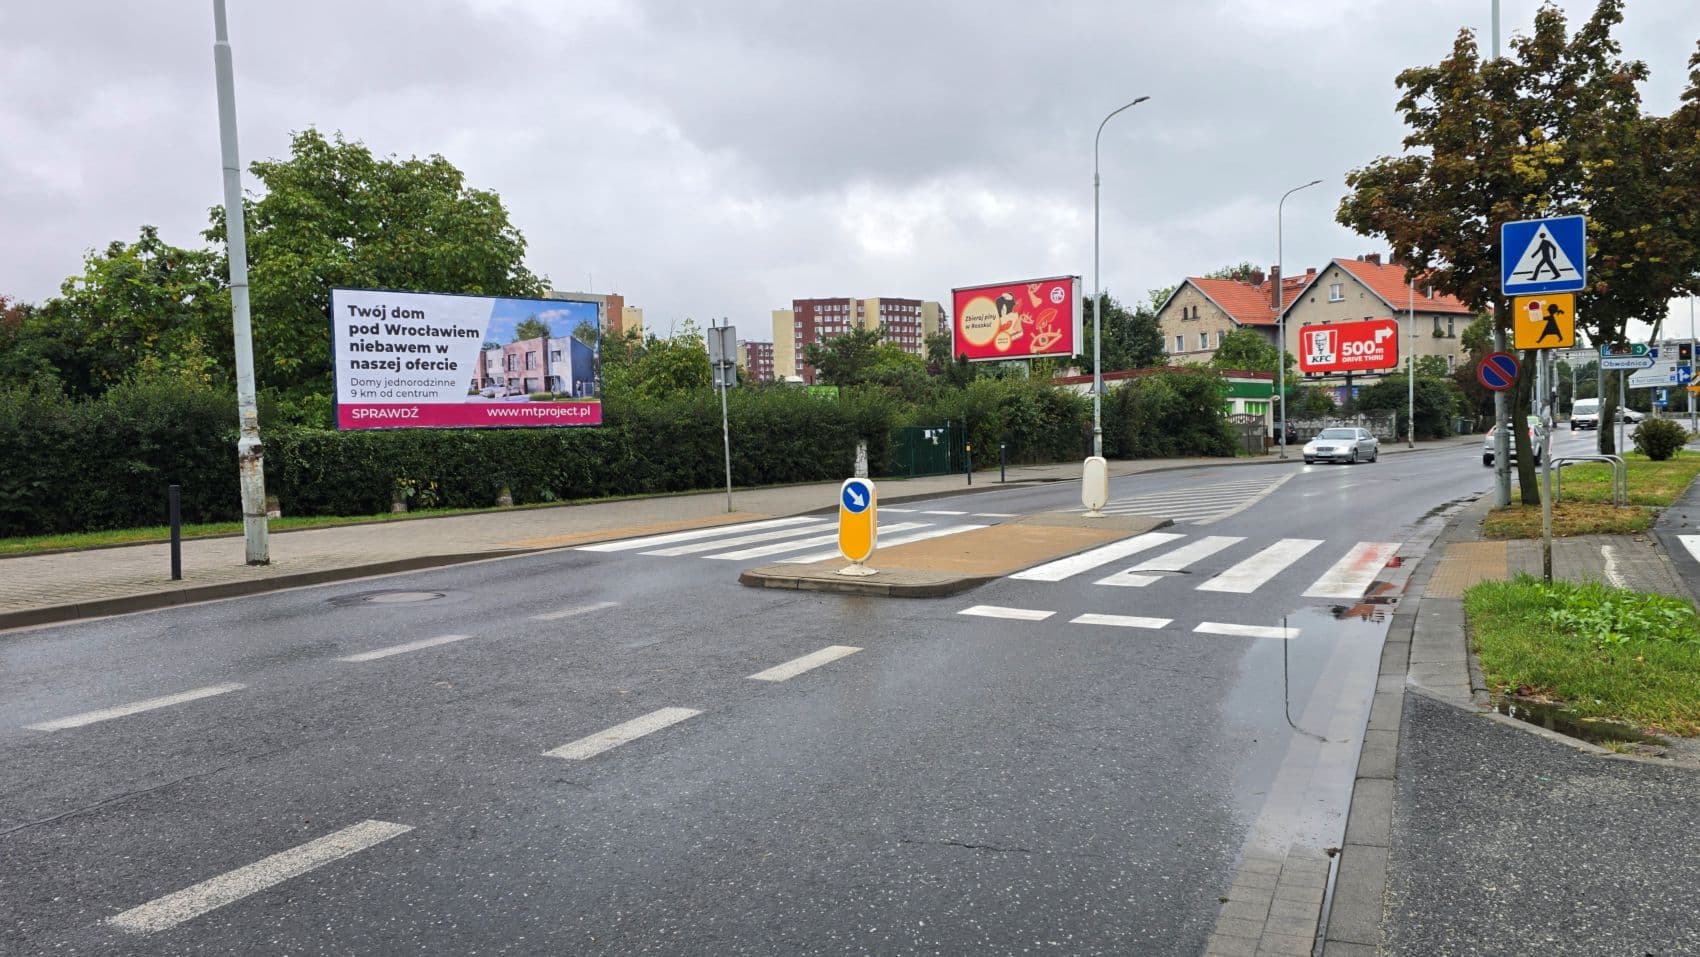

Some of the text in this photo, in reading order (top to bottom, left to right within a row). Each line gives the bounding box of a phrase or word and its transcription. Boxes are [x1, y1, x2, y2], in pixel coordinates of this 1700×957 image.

[347, 305, 425, 320] Twój dom
[349, 323, 480, 338] pod Wrocławiem
[350, 339, 449, 354] niebawem w
[350, 357, 458, 373] naszej ofercie
[1311, 355, 1331, 363] KFC
[1342, 355, 1363, 363] DRIVE
[350, 378, 456, 389] Domy jednorodzinne
[351, 389, 439, 398] 9 km od centrum
[351, 405, 419, 419] SPRAWDŹ
[486, 406, 591, 418] www.mtproject.pl
